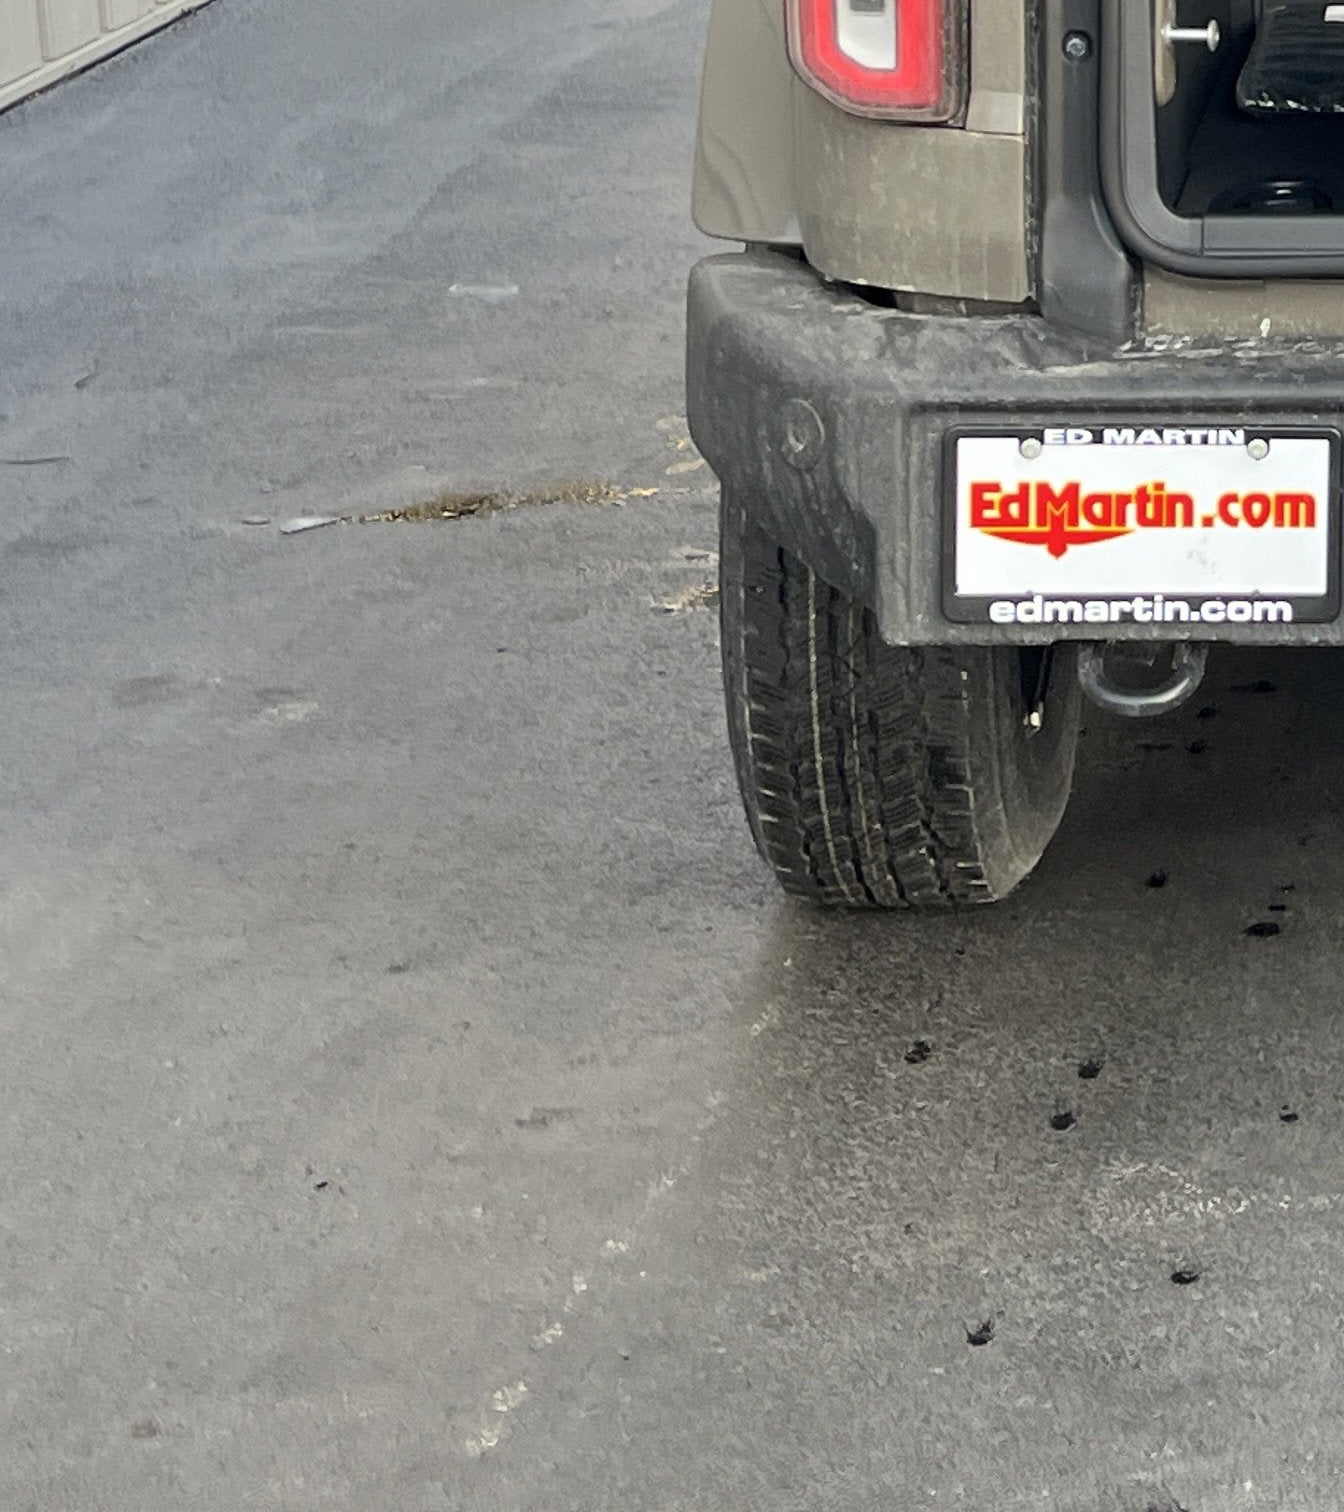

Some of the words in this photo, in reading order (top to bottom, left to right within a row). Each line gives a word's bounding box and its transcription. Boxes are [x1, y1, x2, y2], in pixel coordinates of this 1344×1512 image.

[1043, 428, 1093, 445] ED
[1102, 428, 1246, 445] MARTIN
[988, 594, 1293, 623] edmartin.com
